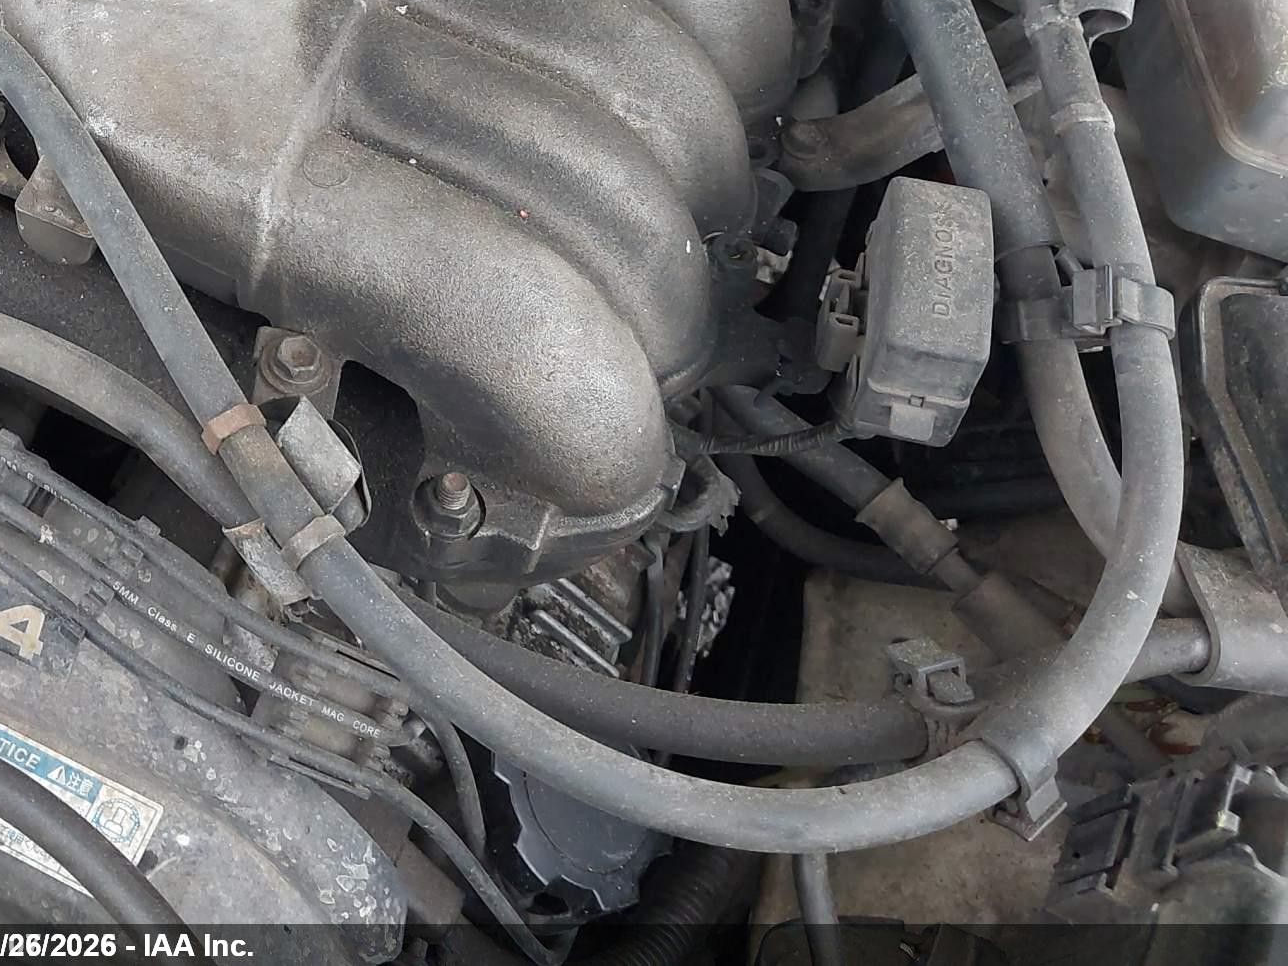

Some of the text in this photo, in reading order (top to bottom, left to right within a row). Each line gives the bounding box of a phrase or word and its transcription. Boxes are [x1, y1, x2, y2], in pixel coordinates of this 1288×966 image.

[112, 581, 381, 739] 5MM Class E SILICONE JACKET MAG CORE
[67, 772, 95, 797] 注意
